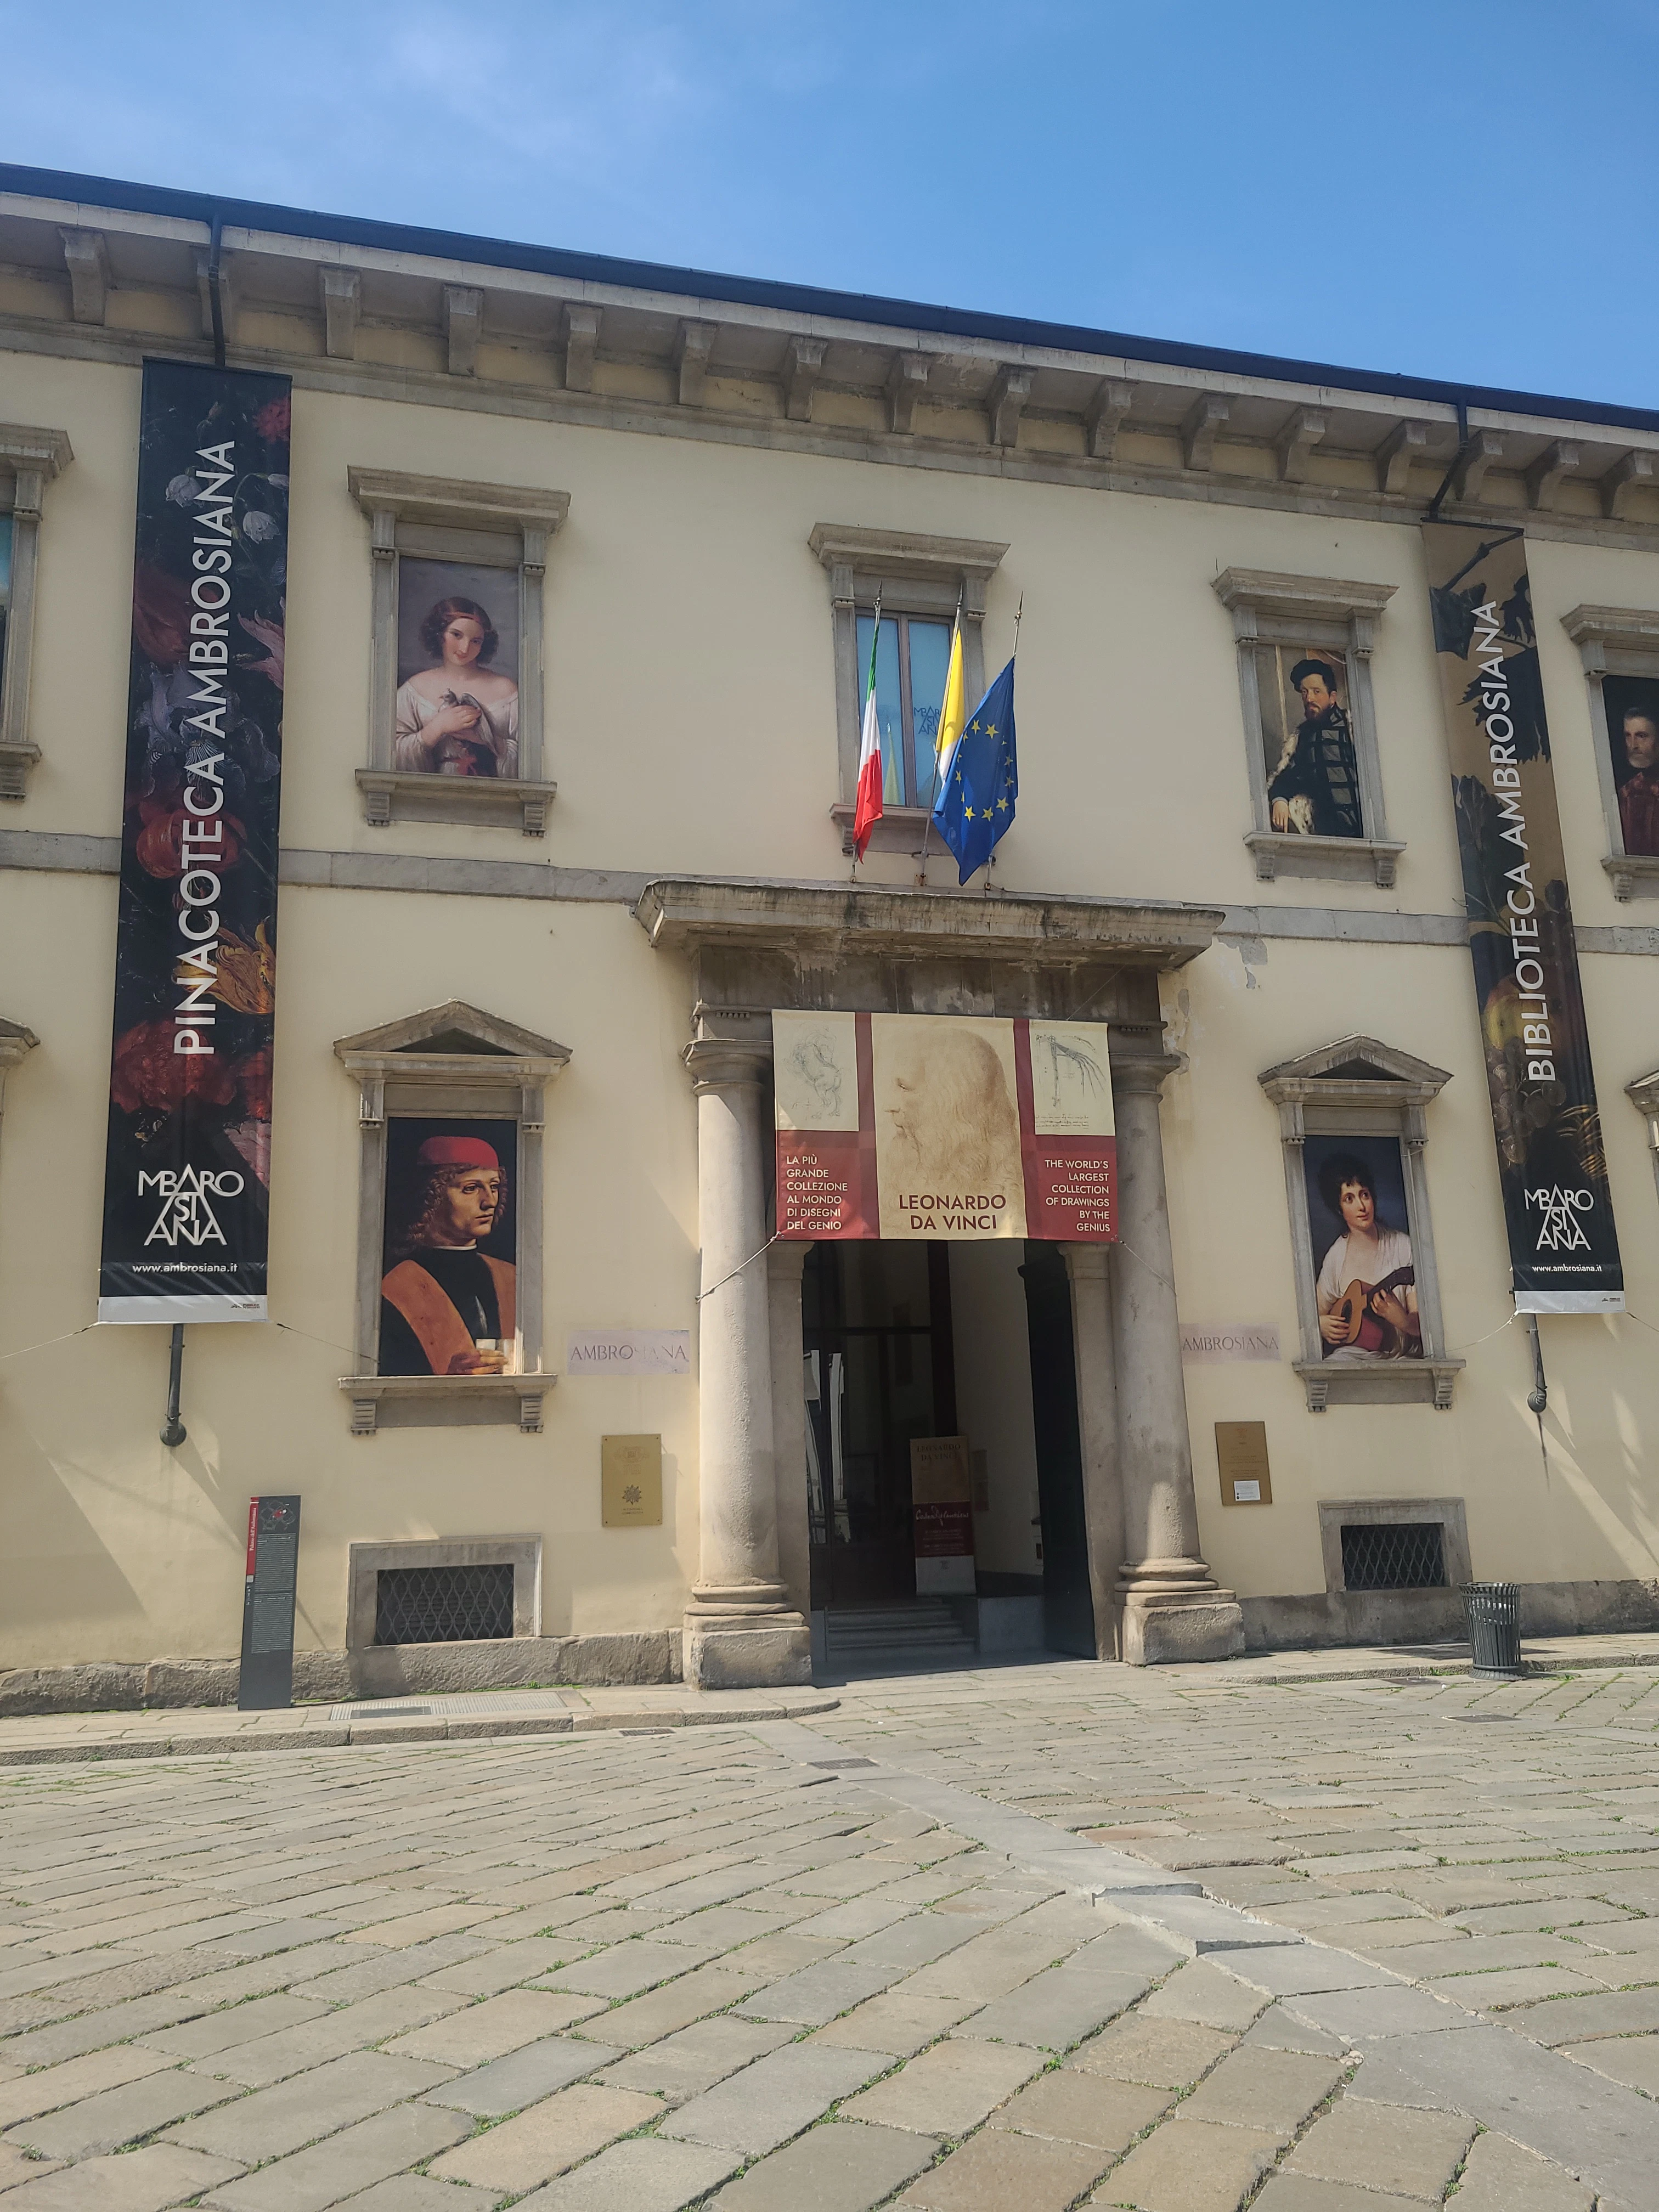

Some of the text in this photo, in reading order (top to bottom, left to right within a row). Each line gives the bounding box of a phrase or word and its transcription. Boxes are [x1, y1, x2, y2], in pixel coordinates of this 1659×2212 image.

[914, 706, 940, 717] MBAR
[174, 441, 235, 1054] PINACOTECA AMBROSIANA
[1470, 601, 1556, 1081] BIBLIOTECA AMBROSIANA
[787, 1154, 817, 1164] LA PIÙ
[1045, 1160, 1109, 1169] THE WORLD'S
[787, 1169, 829, 1177] GRANDE
[1069, 1172, 1109, 1181] LARGEST
[787, 1182, 848, 1191] COLLEZIONE
[1052, 1185, 1109, 1194] COLLECTION
[787, 1195, 842, 1204] AL MONDO
[899, 1194, 1006, 1210] LEONARDO
[1061, 1198, 1109, 1206] DRAWINGS
[787, 1208, 841, 1217] DI DISEGNI
[1080, 1210, 1109, 1219] BY THE
[787, 1221, 842, 1229] DEL GENIO
[911, 1215, 997, 1230] DA VINCI
[1076, 1223, 1110, 1232] GENIUS
[132, 1262, 238, 1273] www.ambrosiana.it
[1532, 1263, 1602, 1272] www.ambrosiana.it
[1183, 1336, 1278, 1351] AMBROSIANA
